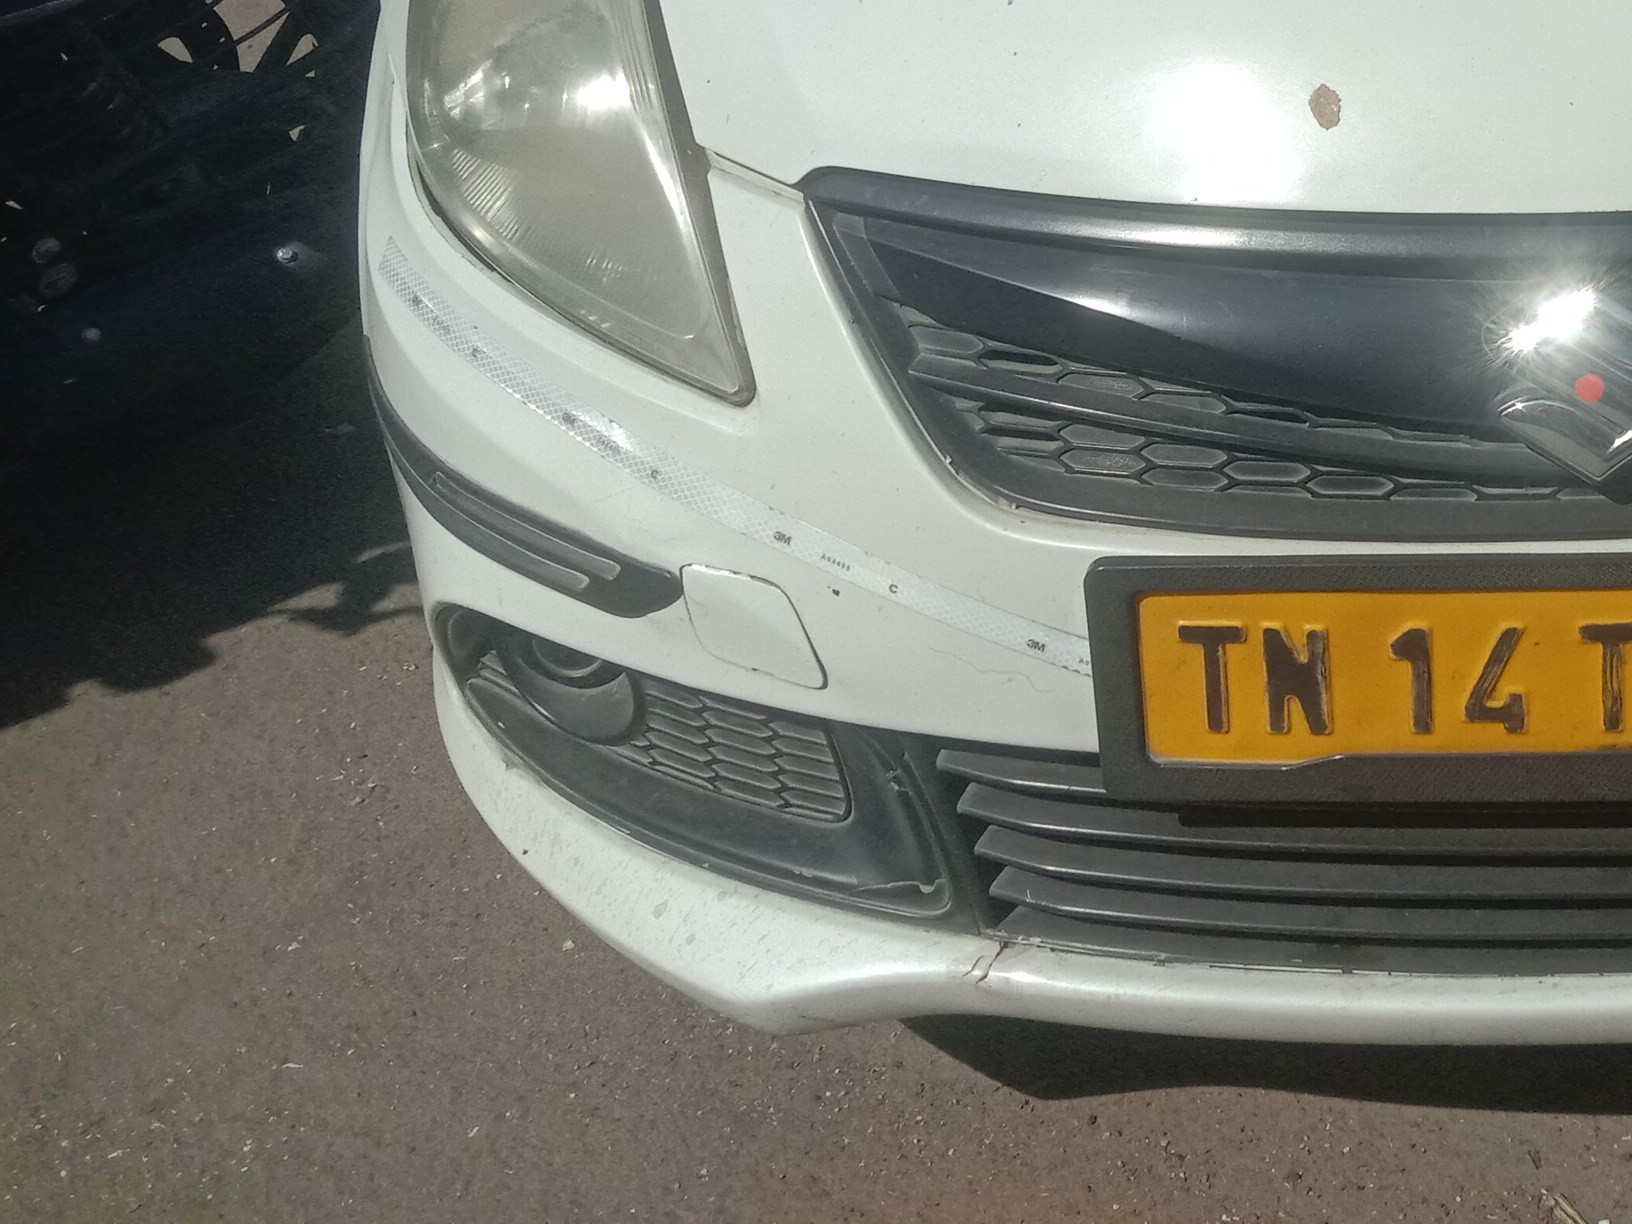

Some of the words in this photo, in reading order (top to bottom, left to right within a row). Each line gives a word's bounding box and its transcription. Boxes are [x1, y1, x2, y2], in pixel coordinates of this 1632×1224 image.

[773, 530, 793, 546] 3M
[888, 583, 899, 595] C
[1026, 638, 1046, 653] 3M
[1177, 624, 1332, 736] TN
[1390, 626, 1526, 734] 14
